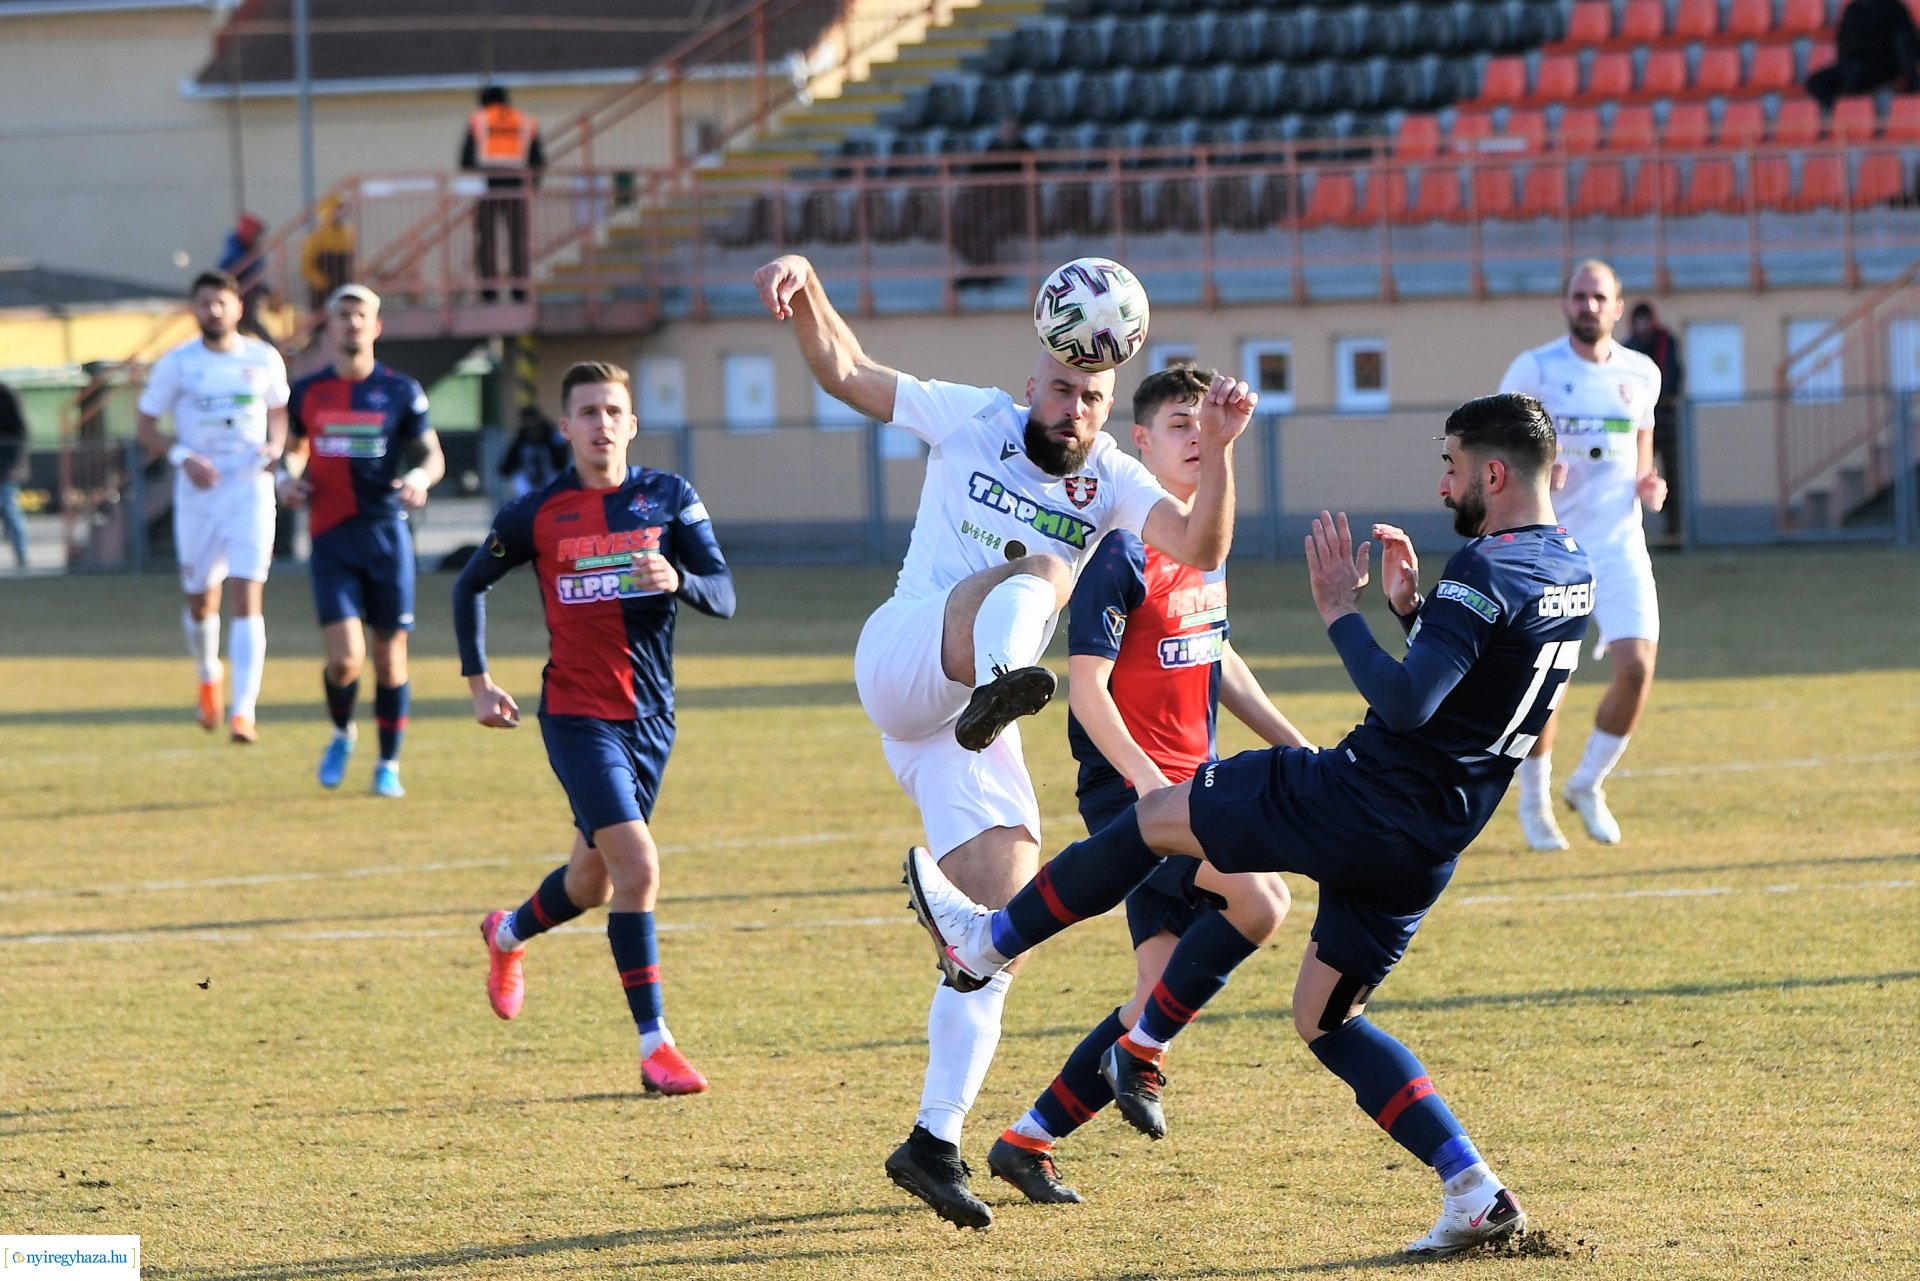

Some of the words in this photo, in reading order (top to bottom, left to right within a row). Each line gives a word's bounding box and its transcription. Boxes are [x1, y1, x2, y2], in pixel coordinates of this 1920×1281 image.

[968, 471, 1097, 550] TiPPMIX
[557, 569, 652, 603] TiPPM
[1438, 581, 1500, 622] TiPPMIX
[1160, 629, 1224, 666] TiPPM
